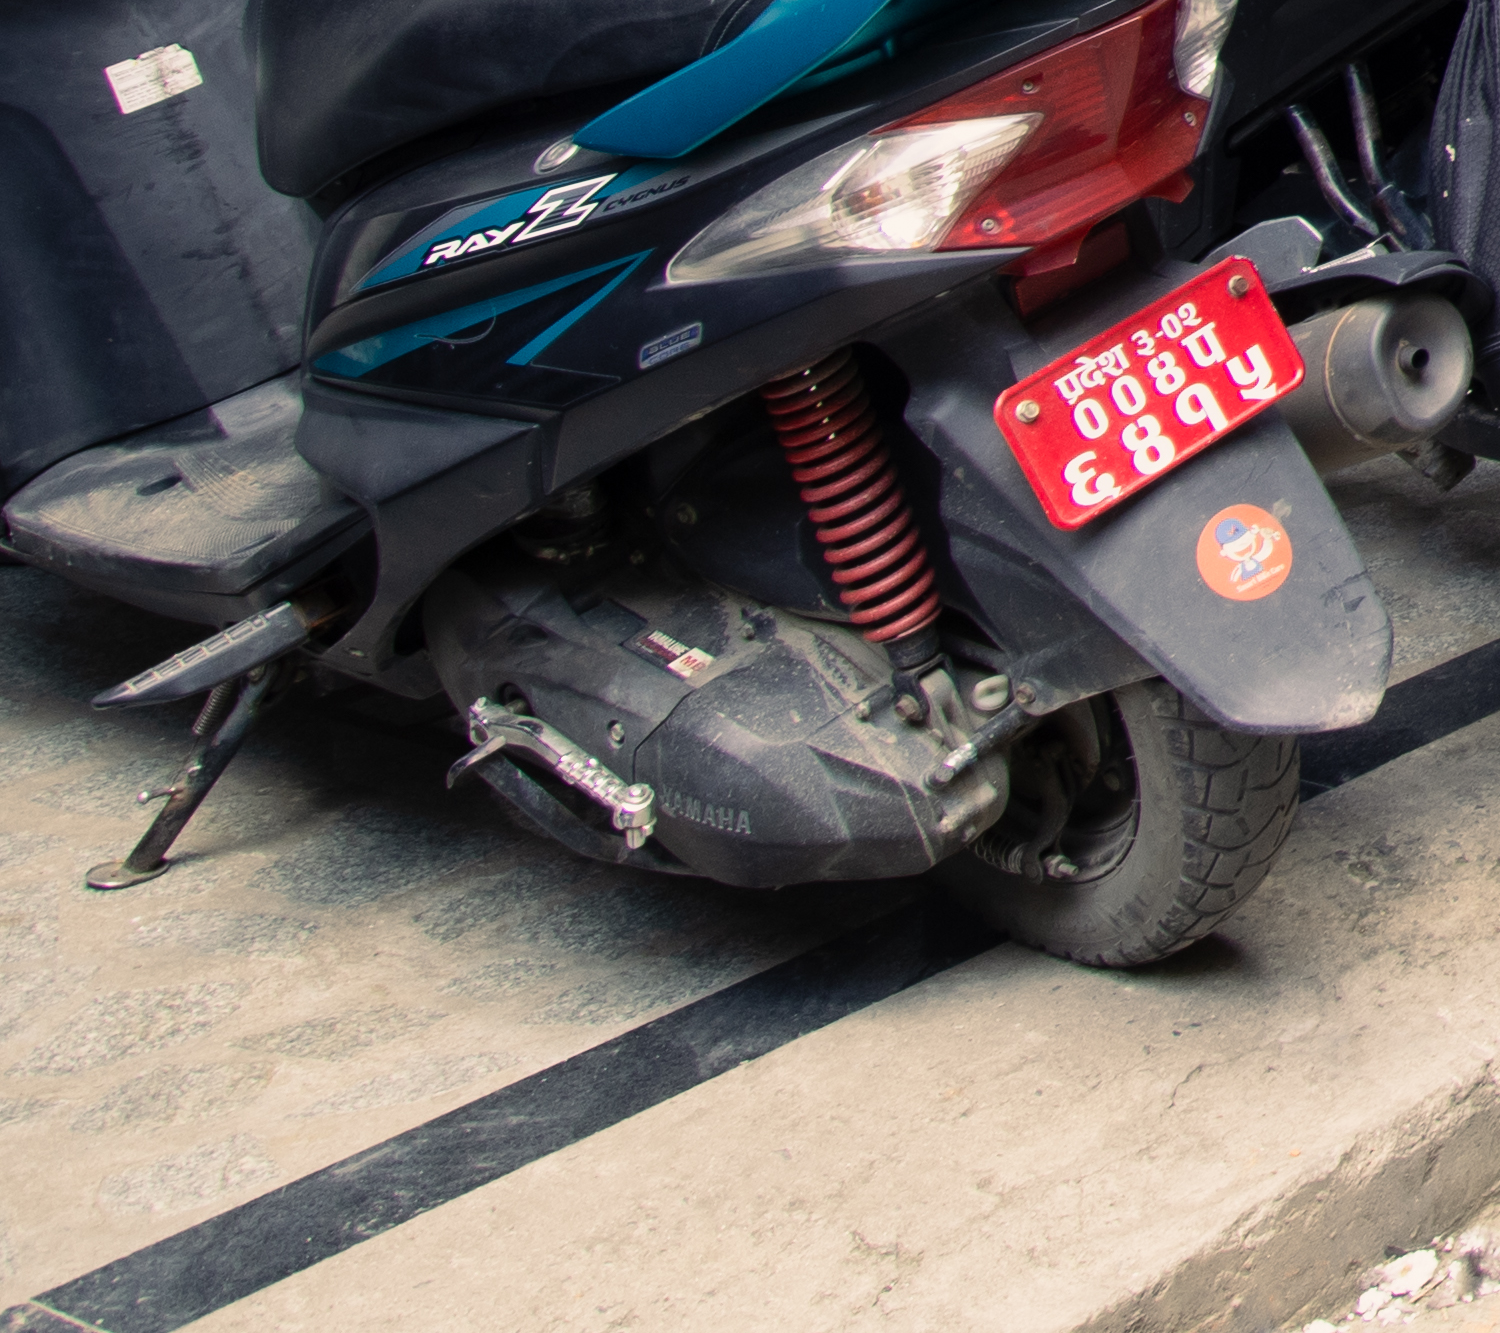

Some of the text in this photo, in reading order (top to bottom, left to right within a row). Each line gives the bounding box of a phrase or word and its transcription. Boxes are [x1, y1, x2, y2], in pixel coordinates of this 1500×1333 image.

[603, 175, 691, 213] CYGNUS
[1053, 343, 1131, 406] प्रदेश
[1062, 343, 1278, 507] ६४१५
[660, 785, 752, 835] YAMAHA
